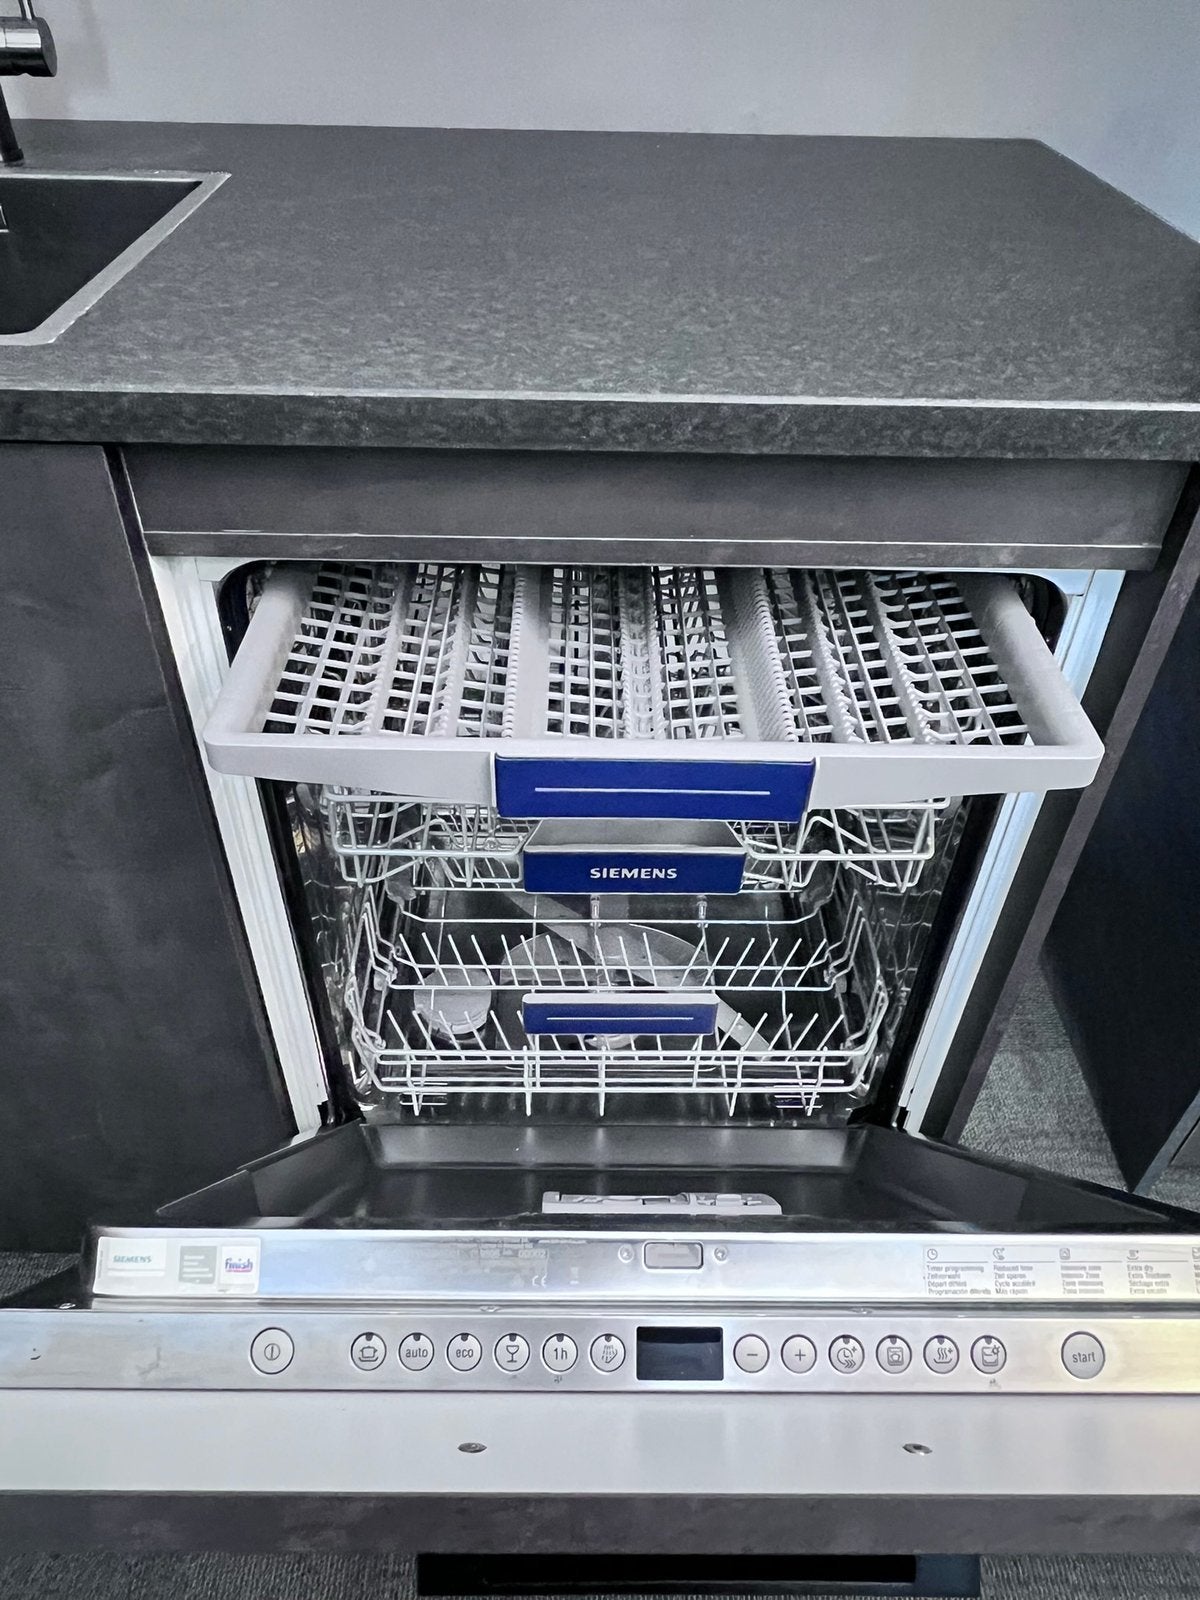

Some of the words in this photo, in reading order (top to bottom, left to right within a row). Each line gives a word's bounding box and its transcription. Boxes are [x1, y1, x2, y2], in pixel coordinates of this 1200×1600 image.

[590, 867, 678, 879] SIEMENS
[113, 1255, 152, 1264] SIEMENS
[224, 1257, 254, 1272] finish
[405, 1347, 428, 1358] auto
[455, 1348, 474, 1359] eco
[1072, 1351, 1096, 1363] start
